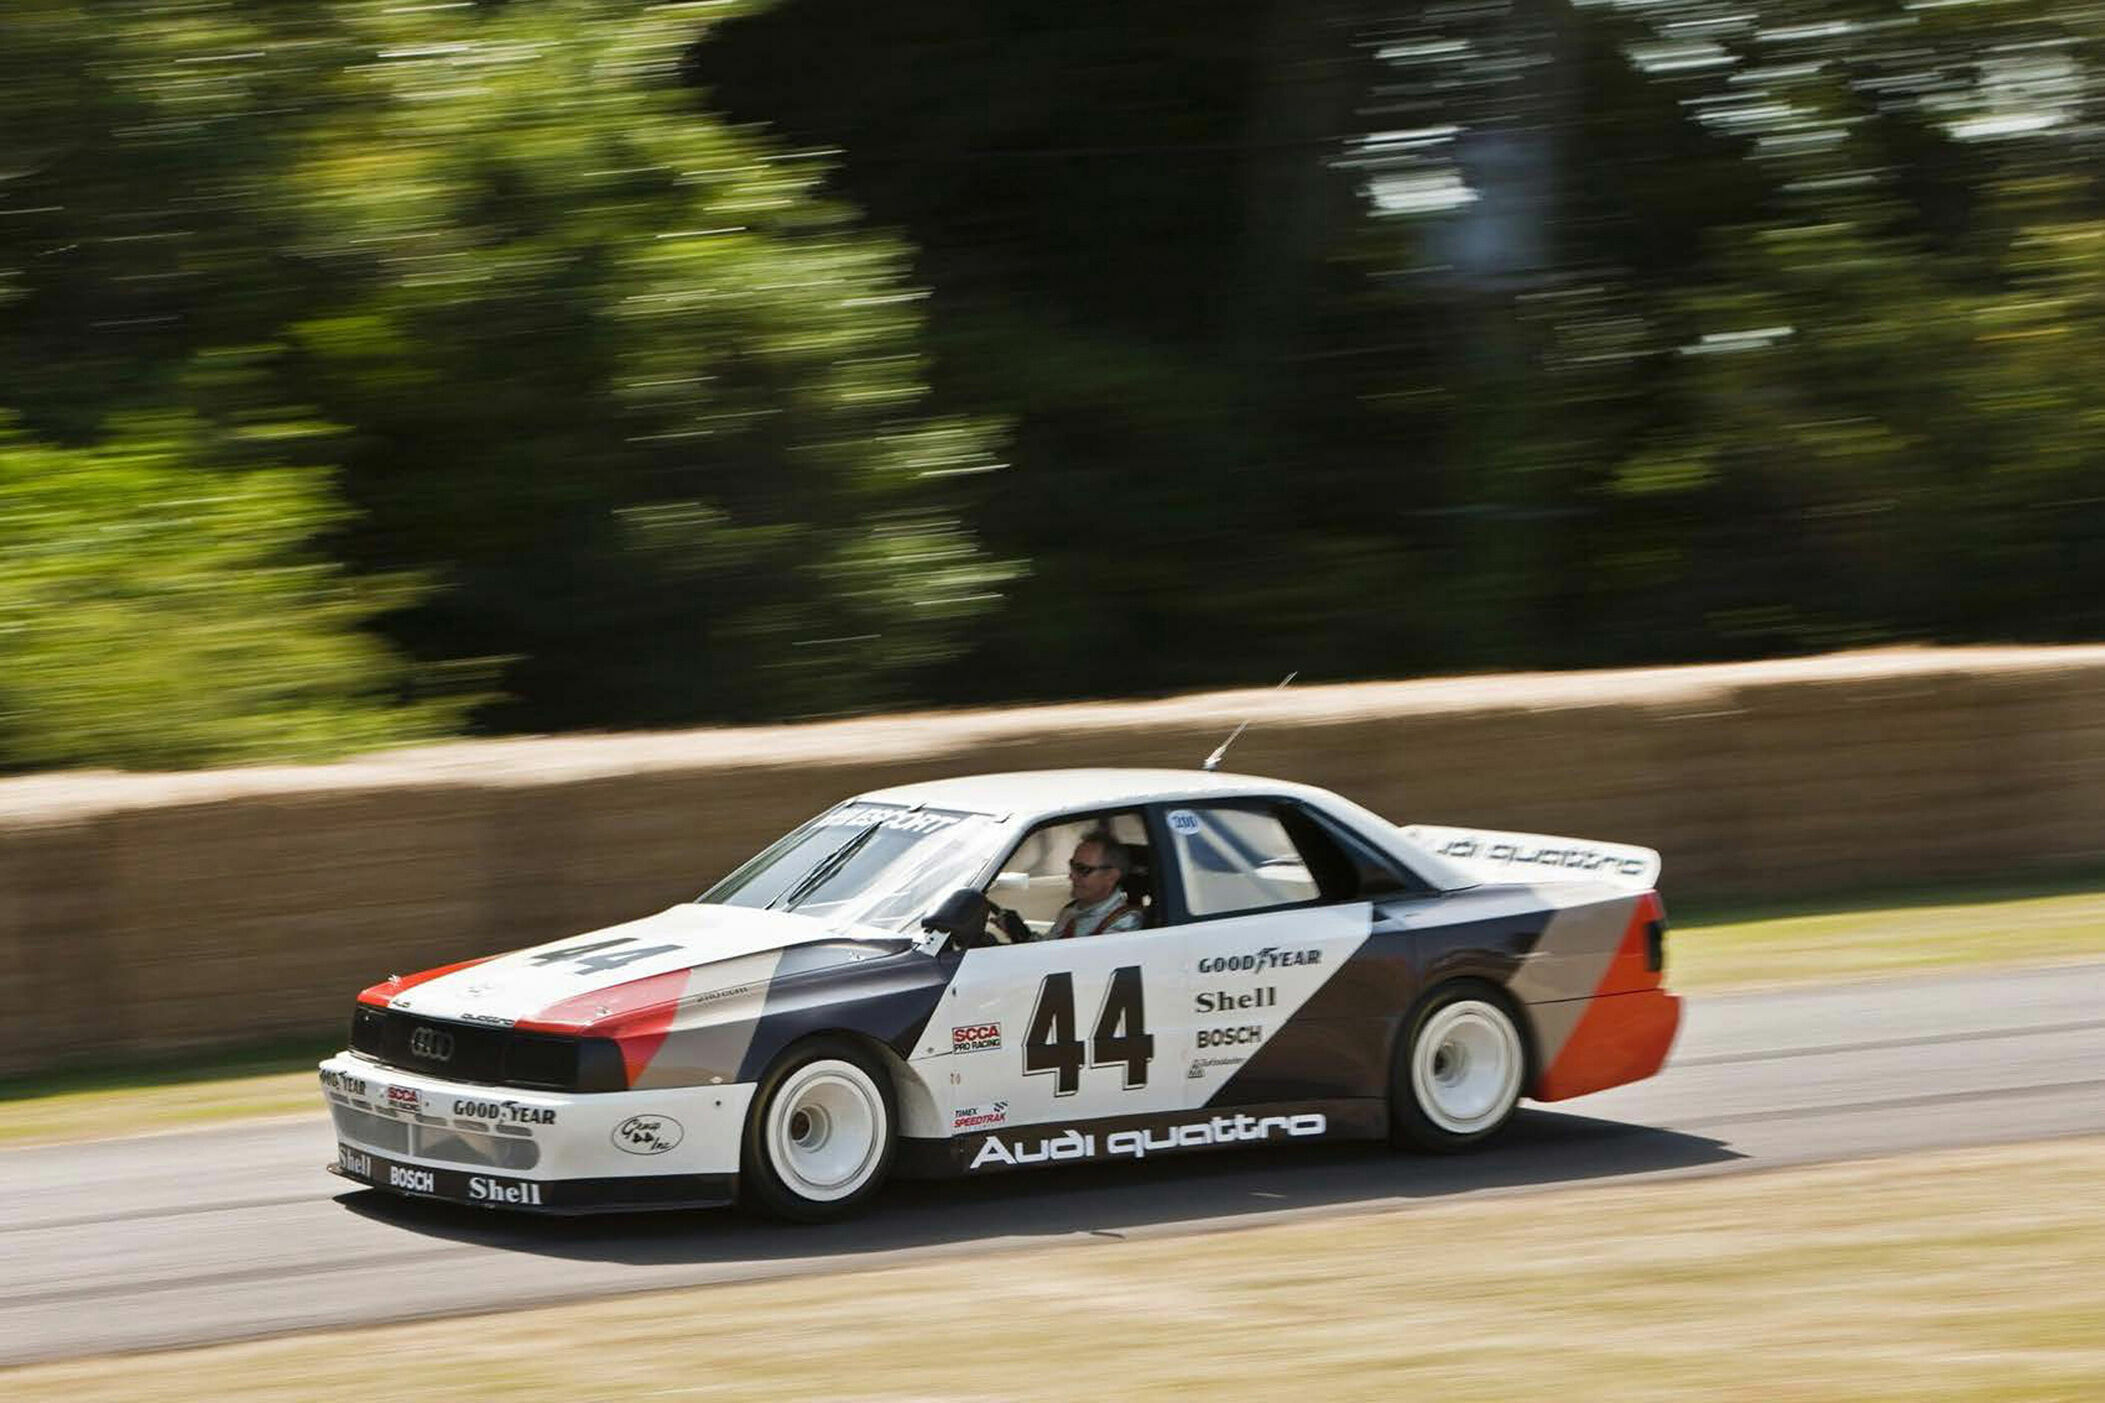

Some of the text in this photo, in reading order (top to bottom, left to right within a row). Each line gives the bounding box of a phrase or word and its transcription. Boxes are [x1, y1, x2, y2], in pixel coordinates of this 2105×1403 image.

[528, 937, 687, 976] 44
[1195, 987, 1276, 1013] Shell
[954, 1025, 999, 1042] SCCA
[1021, 965, 1154, 1098] 44
[1197, 1025, 1263, 1049] BOSCH
[954, 1038, 1000, 1053] PRO RACING
[954, 1113, 1007, 1129] SPEEDTRAK
[955, 1107, 979, 1118] TIMEX
[969, 1113, 1327, 1169] Audi quattro
[339, 1146, 372, 1178] Shell
[390, 1165, 435, 1193] BOSCH
[469, 1176, 543, 1205] Shell
